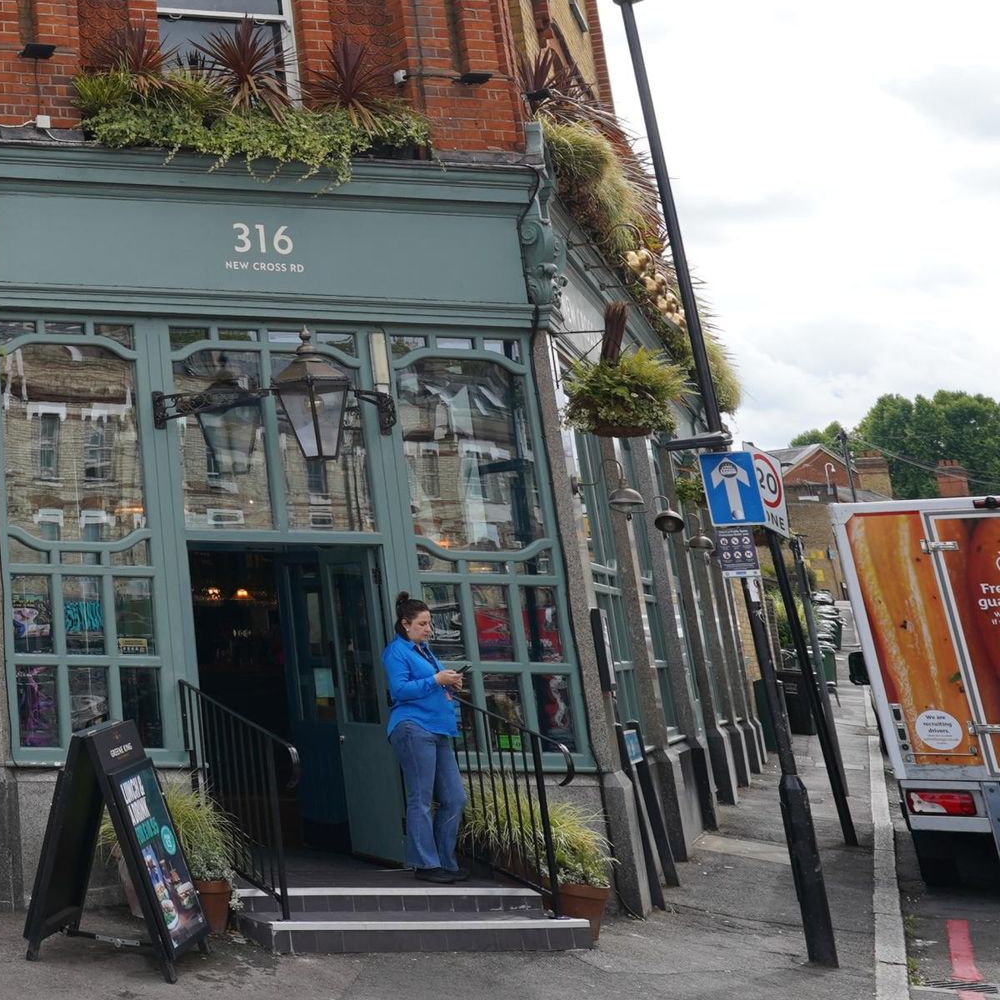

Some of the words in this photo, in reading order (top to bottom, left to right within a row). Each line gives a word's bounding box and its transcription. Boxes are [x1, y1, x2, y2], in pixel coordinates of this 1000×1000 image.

[232, 222, 293, 255] 316
[225, 260, 249, 270] NEW
[252, 262, 288, 272] CROSS
[290, 264, 305, 273] RD
[756, 467, 777, 495] 20
